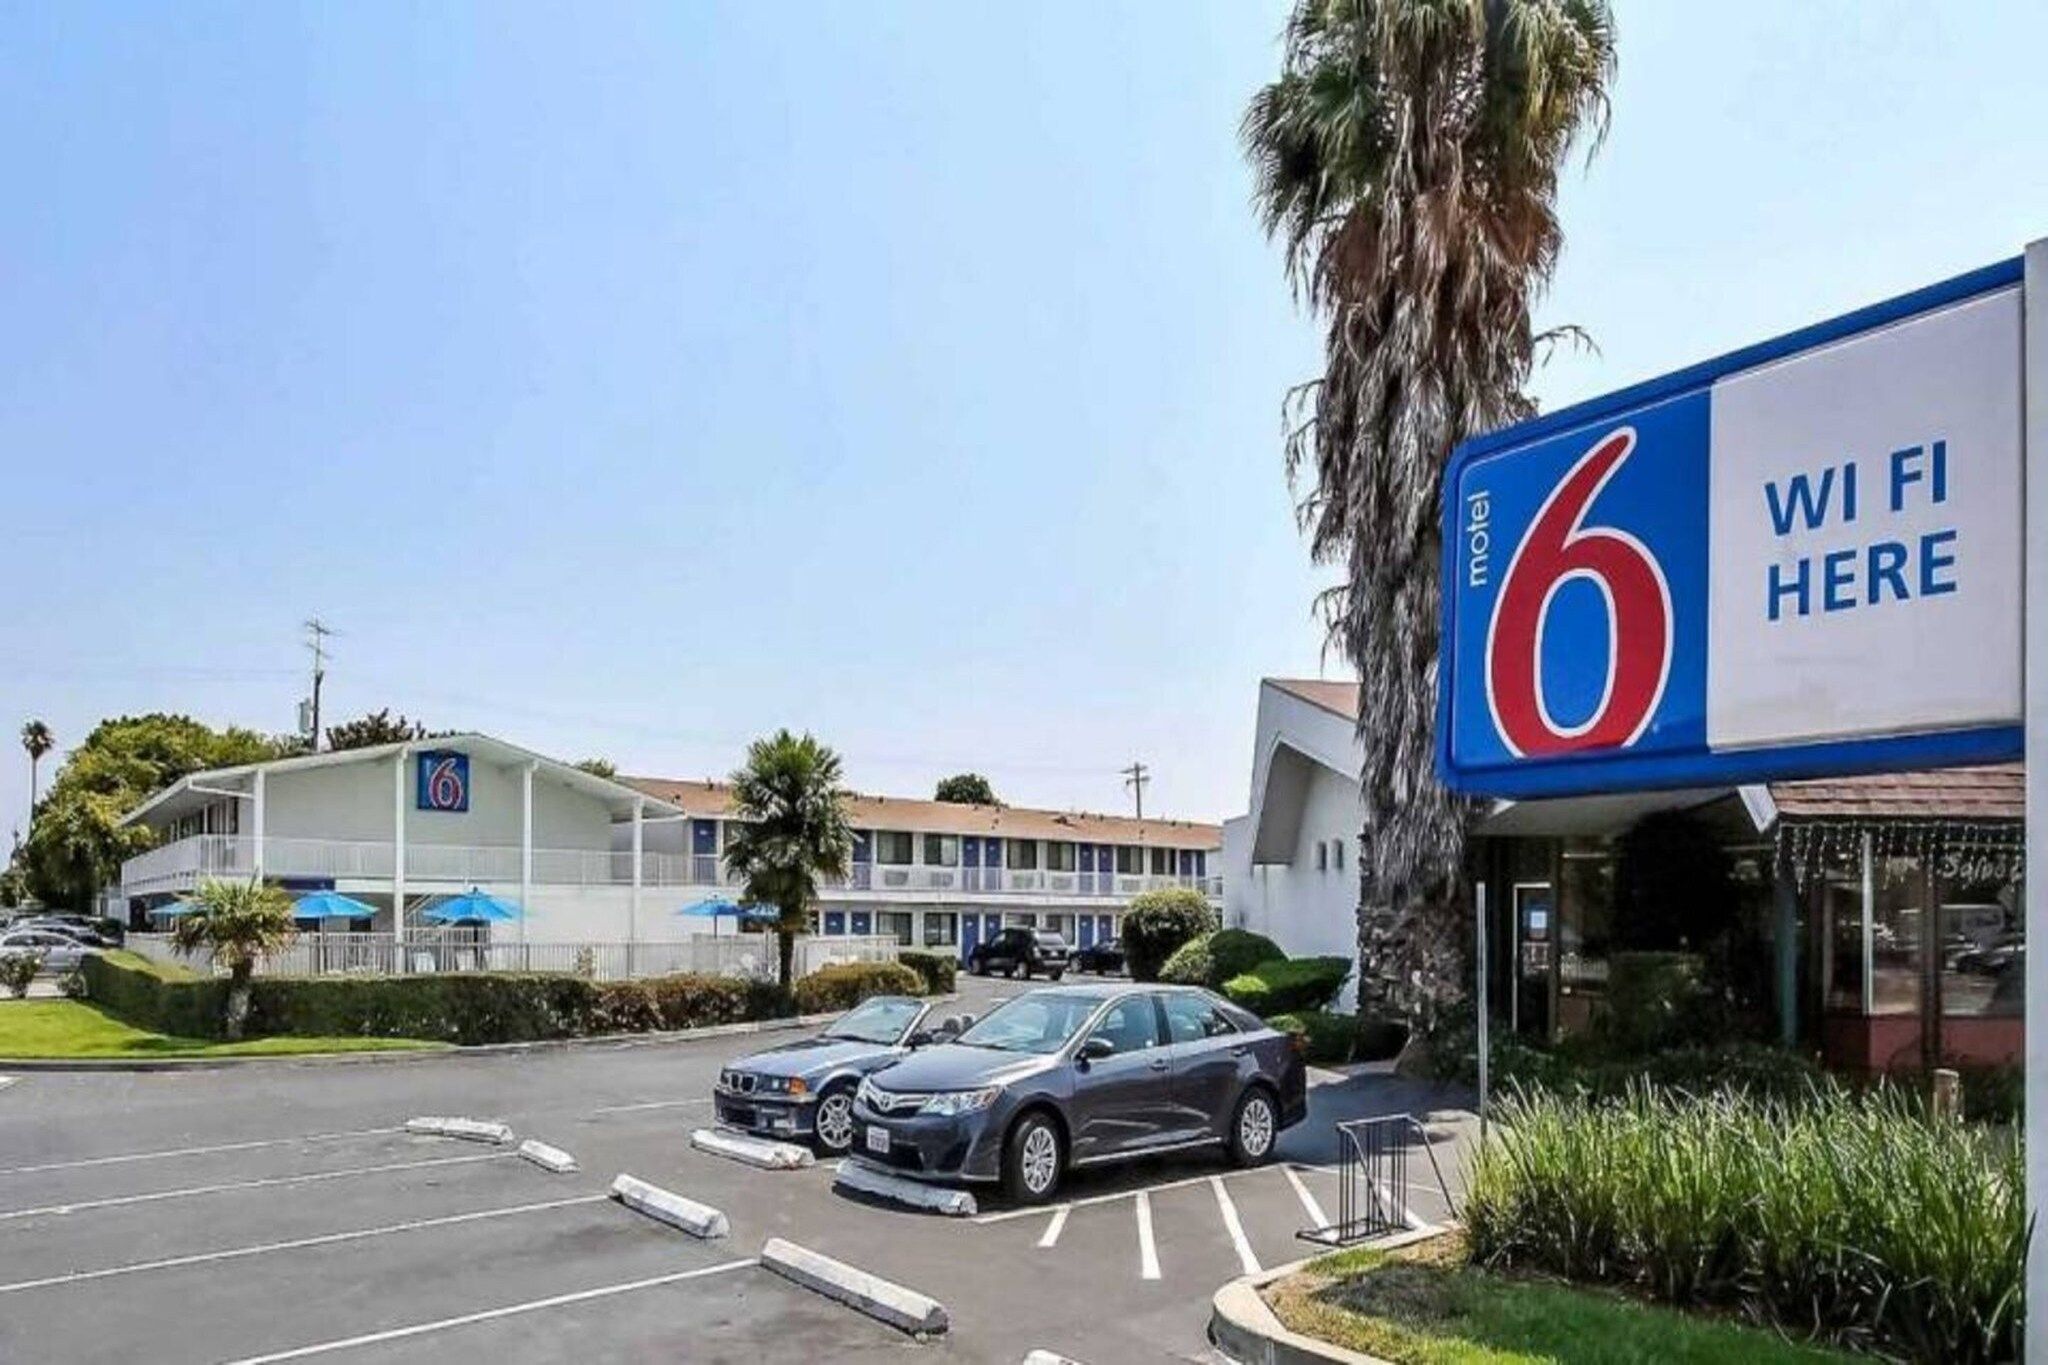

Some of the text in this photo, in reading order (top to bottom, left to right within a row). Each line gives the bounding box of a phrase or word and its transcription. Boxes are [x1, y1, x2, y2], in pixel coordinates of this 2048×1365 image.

[1764, 440, 1947, 536] WI FI
[1466, 489, 1491, 588] motel
[1768, 529, 1957, 621] HERE
[1484, 425, 1676, 759] 6
[428, 757, 463, 809] 6
